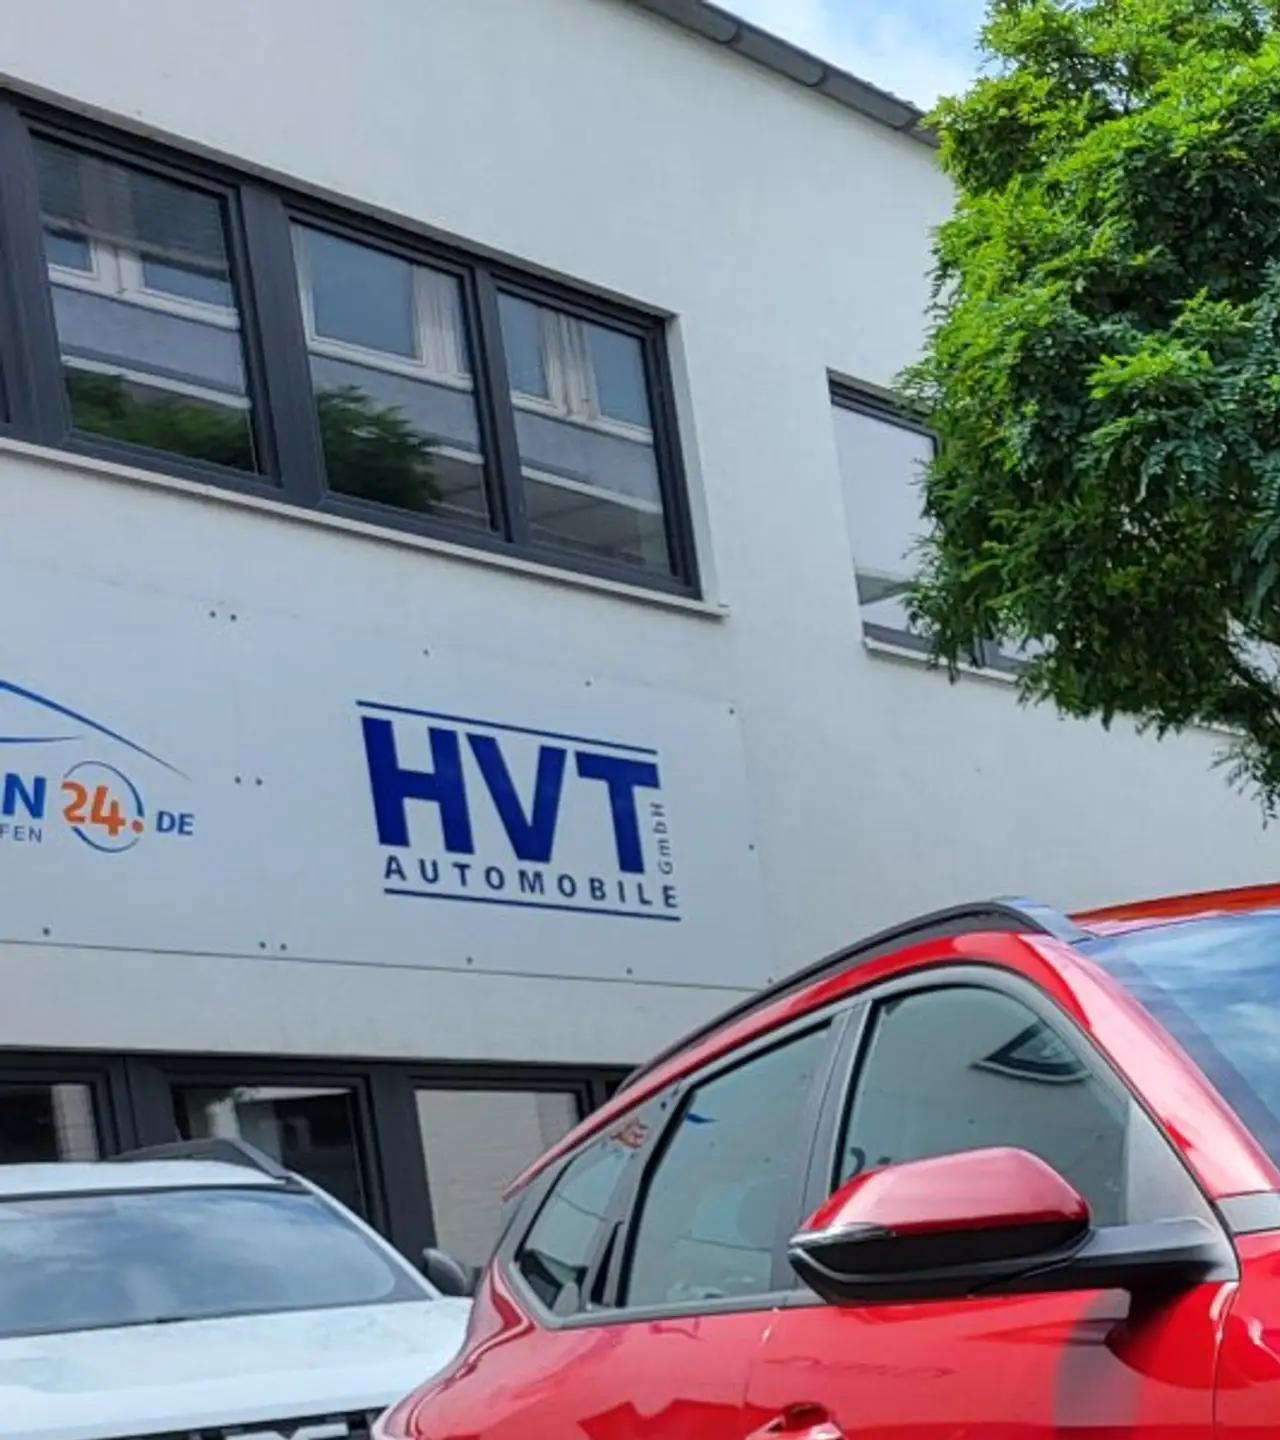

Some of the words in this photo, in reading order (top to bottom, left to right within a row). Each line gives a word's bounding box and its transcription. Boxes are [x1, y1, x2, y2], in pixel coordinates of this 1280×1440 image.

[361, 715, 661, 875] HVT
[649, 802, 674, 875] GmbH
[383, 855, 679, 908] AUTOMOBILE
